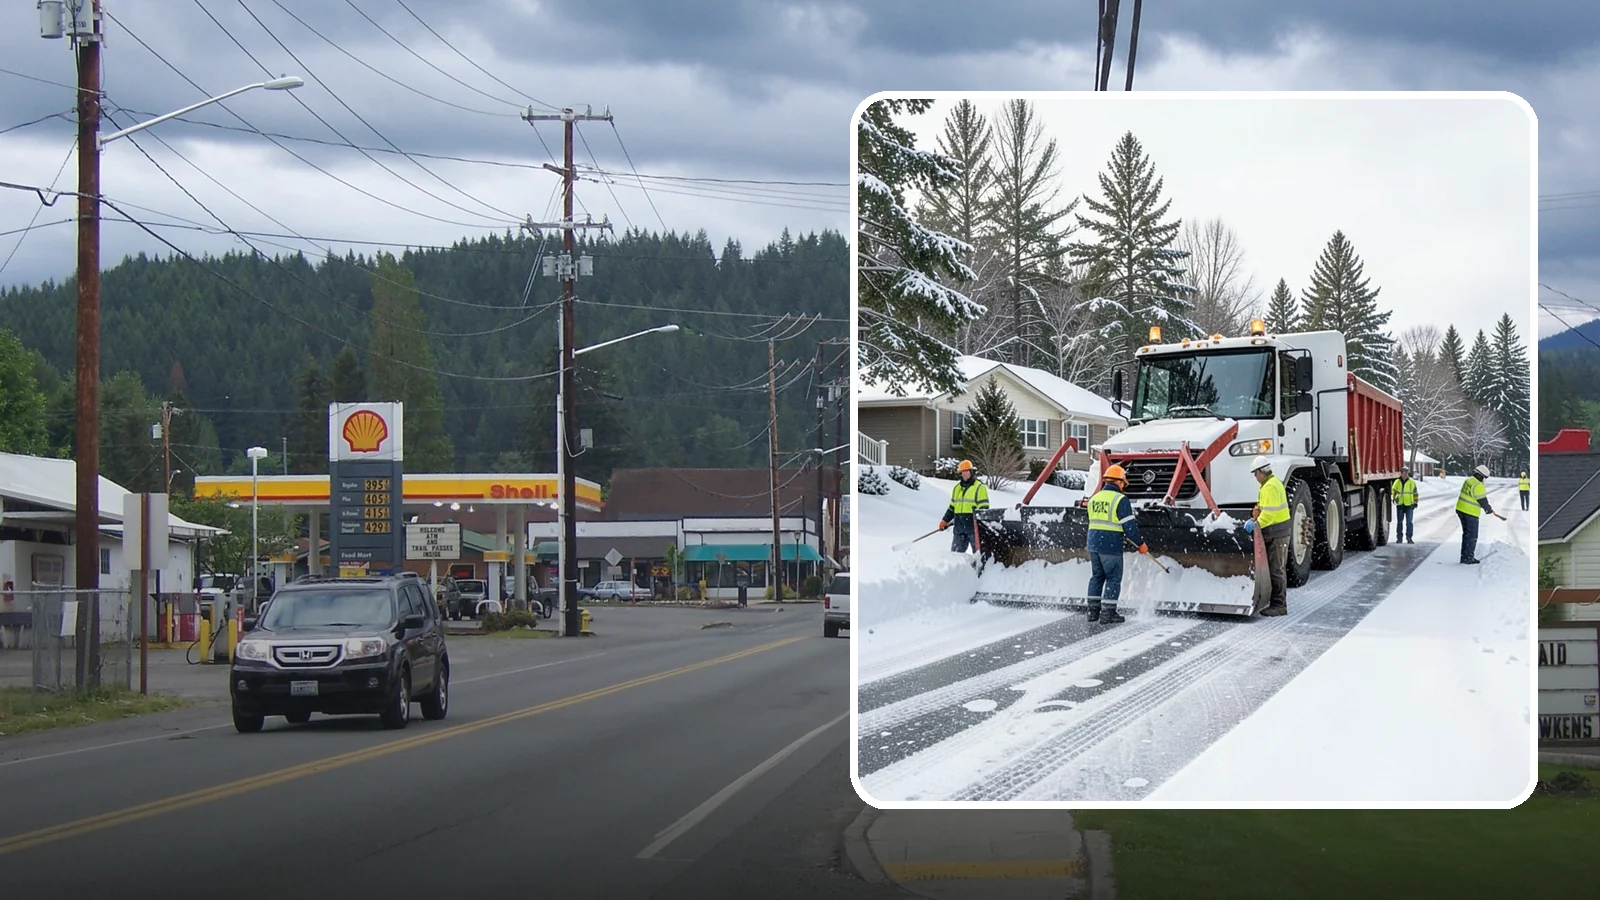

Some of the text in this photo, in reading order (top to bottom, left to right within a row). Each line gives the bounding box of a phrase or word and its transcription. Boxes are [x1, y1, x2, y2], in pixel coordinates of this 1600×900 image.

[366, 480, 383, 490] 395
[490, 484, 547, 499] Shell
[366, 494, 383, 504] 405
[366, 508, 383, 518] 415
[366, 522, 383, 532] 429
[1539, 643, 1567, 665] AID
